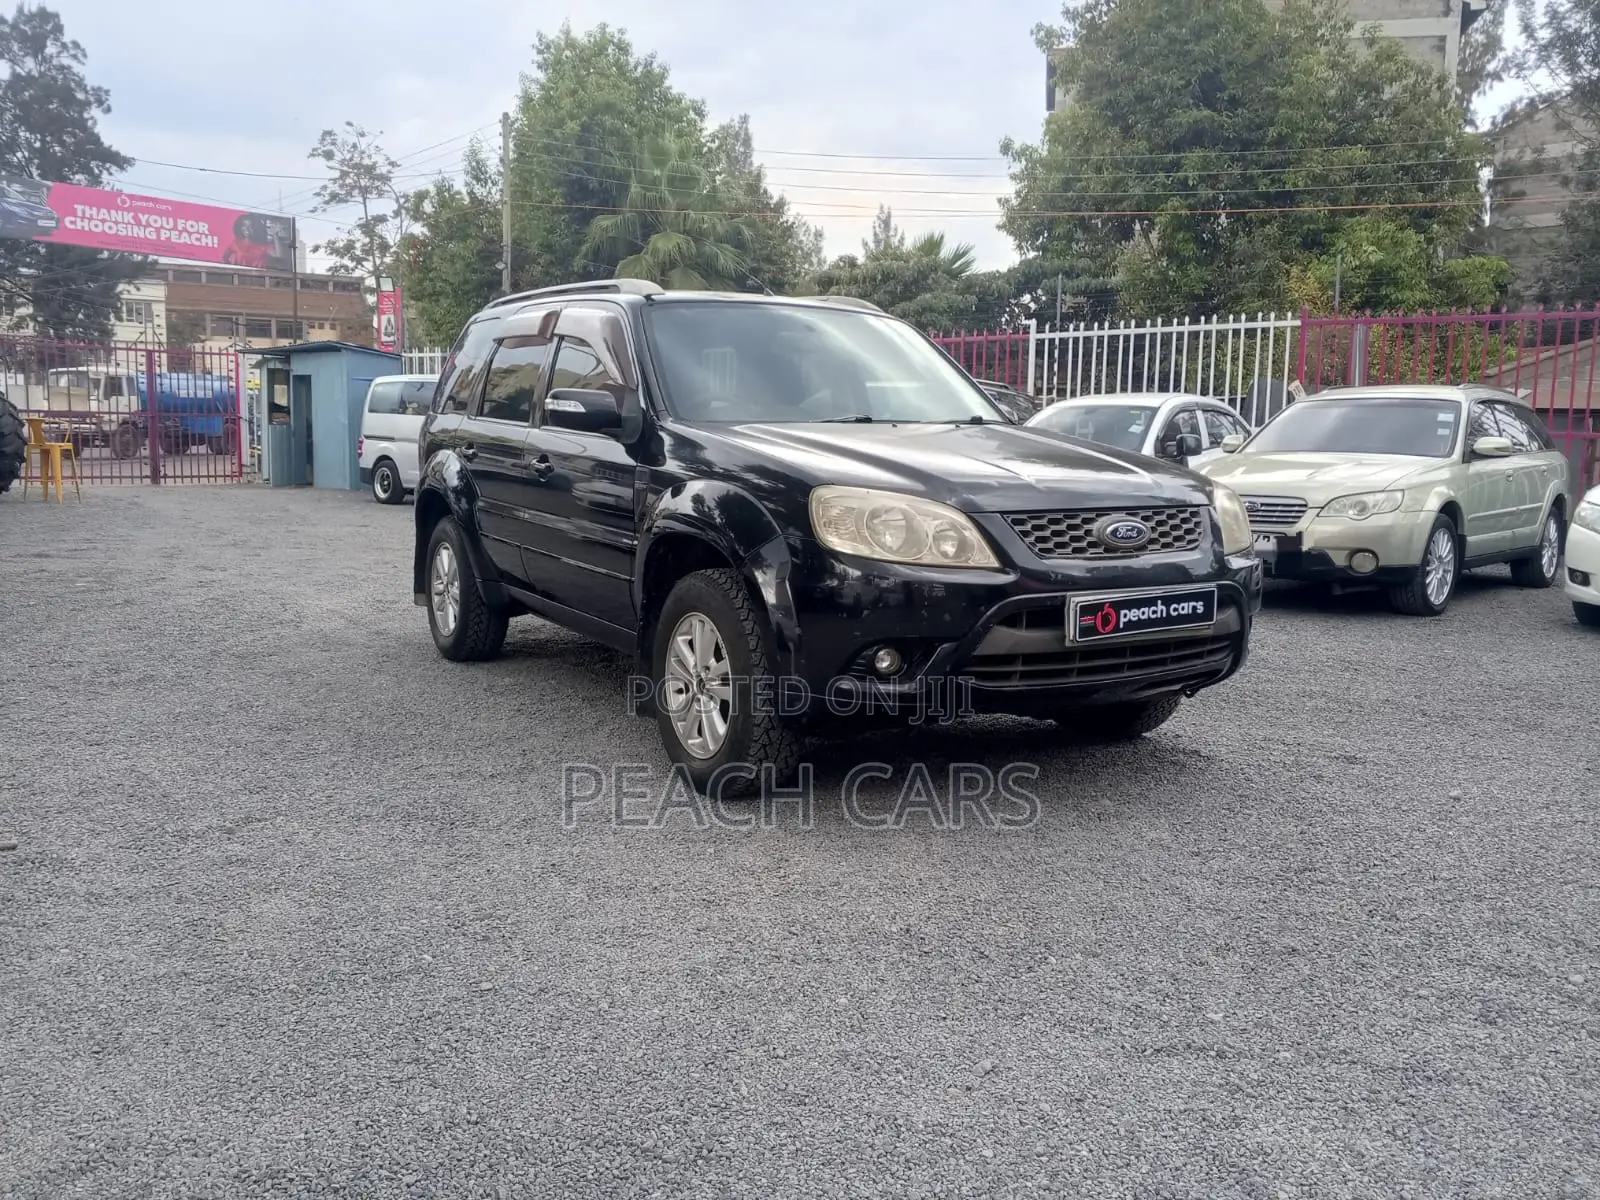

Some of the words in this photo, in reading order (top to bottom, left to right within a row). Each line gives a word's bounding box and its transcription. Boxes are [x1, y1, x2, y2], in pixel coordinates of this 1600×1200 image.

[64, 216, 157, 240] CHOOSING
[160, 229, 219, 248] PEACH!
[74, 204, 136, 225] THANK
[137, 212, 174, 230] YOU
[177, 218, 210, 234] FOR
[1116, 526, 1138, 538] Ford
[1119, 600, 1167, 629] peach
[1169, 601, 1204, 616] cars
